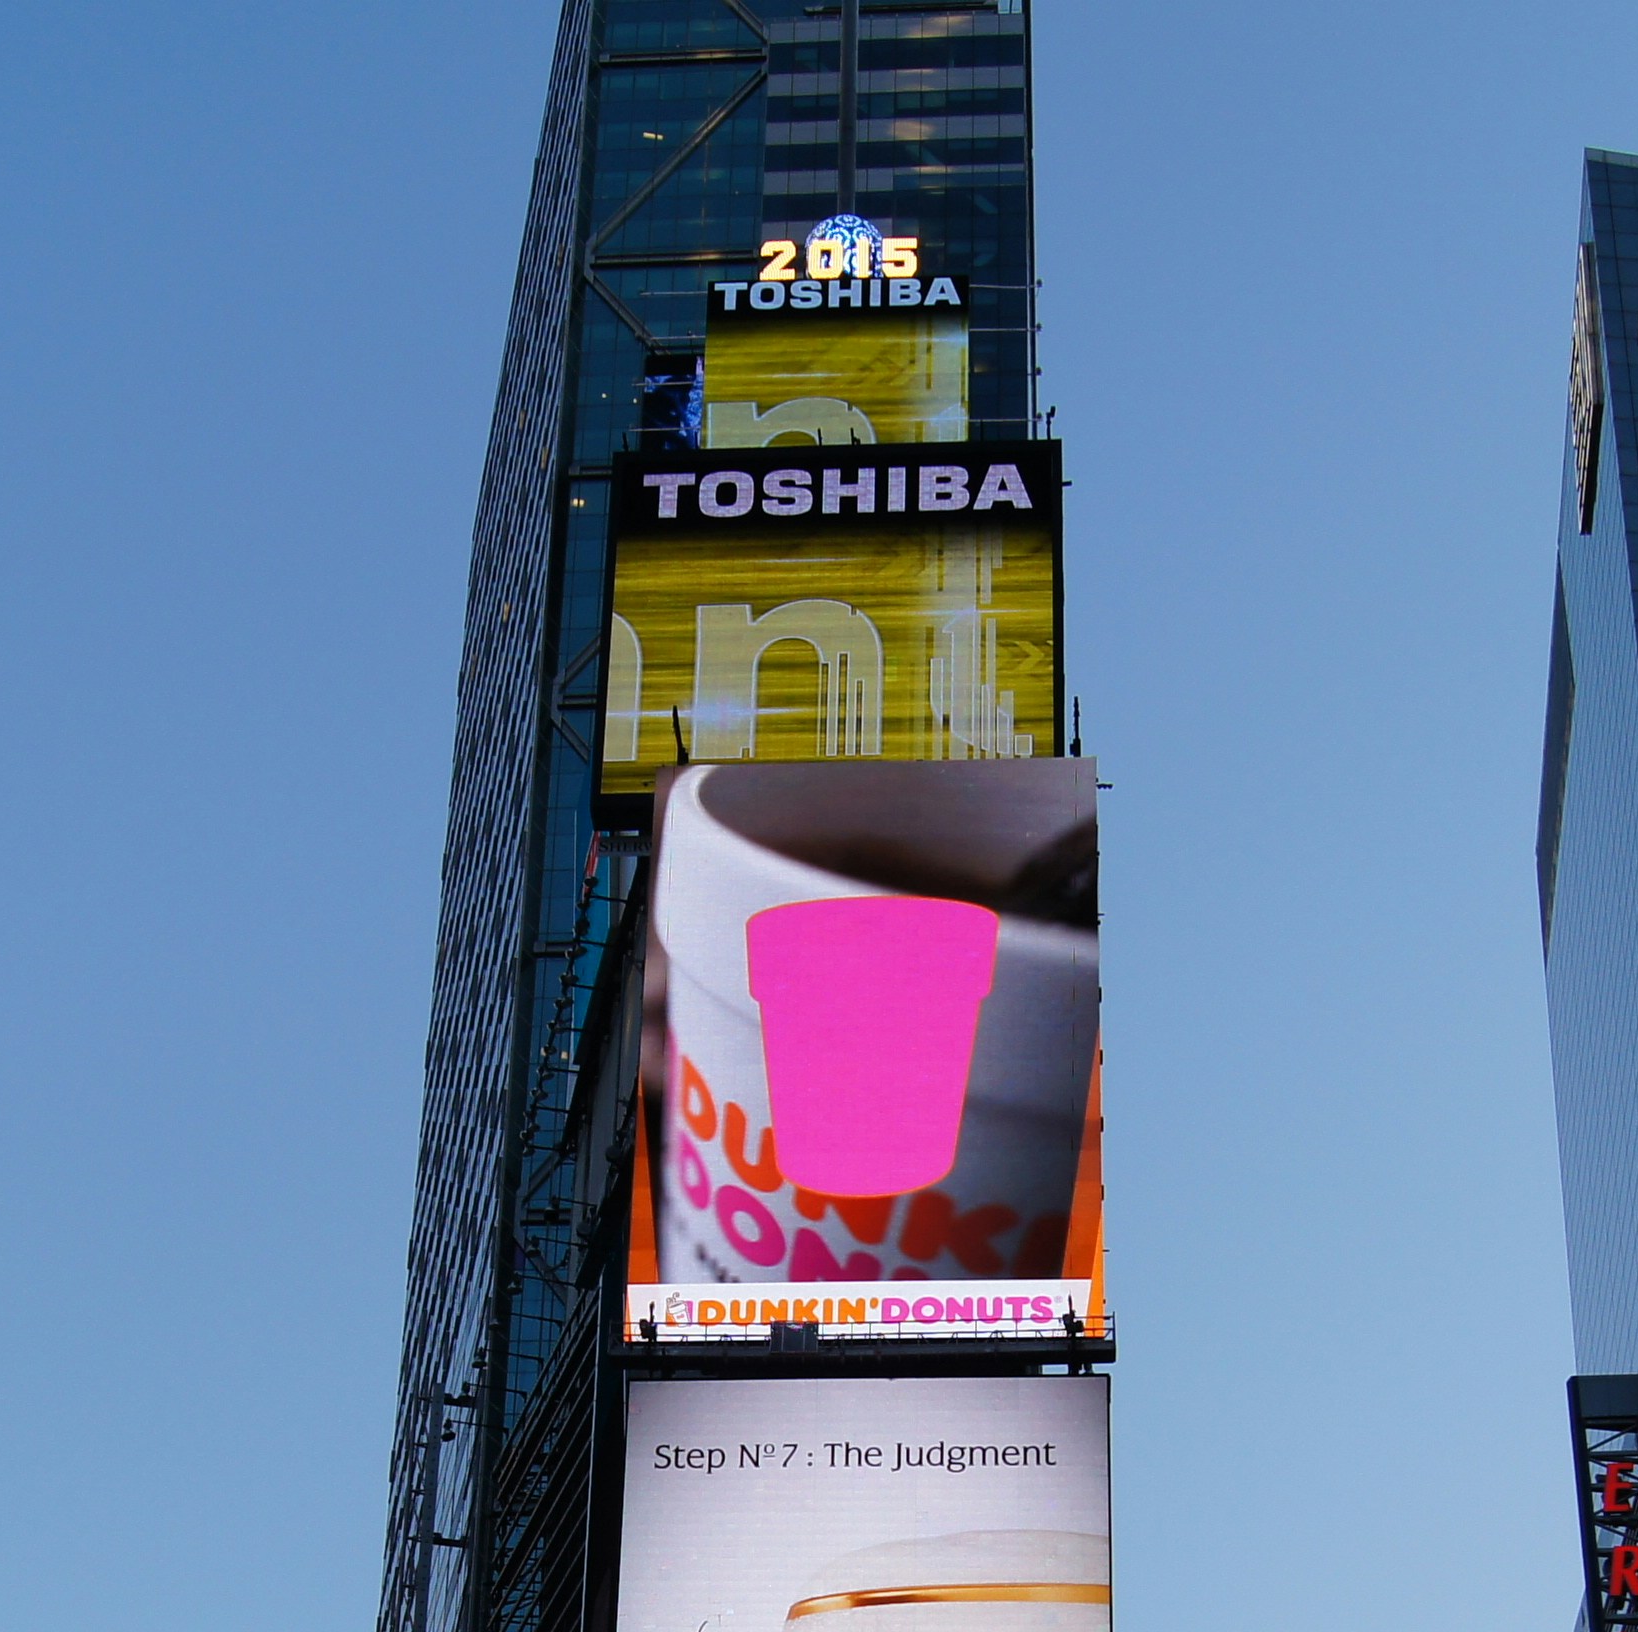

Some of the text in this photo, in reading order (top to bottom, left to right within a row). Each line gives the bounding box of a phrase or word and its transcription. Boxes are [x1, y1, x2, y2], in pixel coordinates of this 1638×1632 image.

[759, 237, 919, 281] 2015
[714, 277, 961, 311] TOSHIBA
[643, 464, 1033, 518] TOSHIBA
[697, 1296, 1053, 1325] DUNKIN' DONUTS
[654, 1443, 726, 1476] Step
[824, 1441, 883, 1468] The
[891, 1441, 1057, 1474] Judgment
